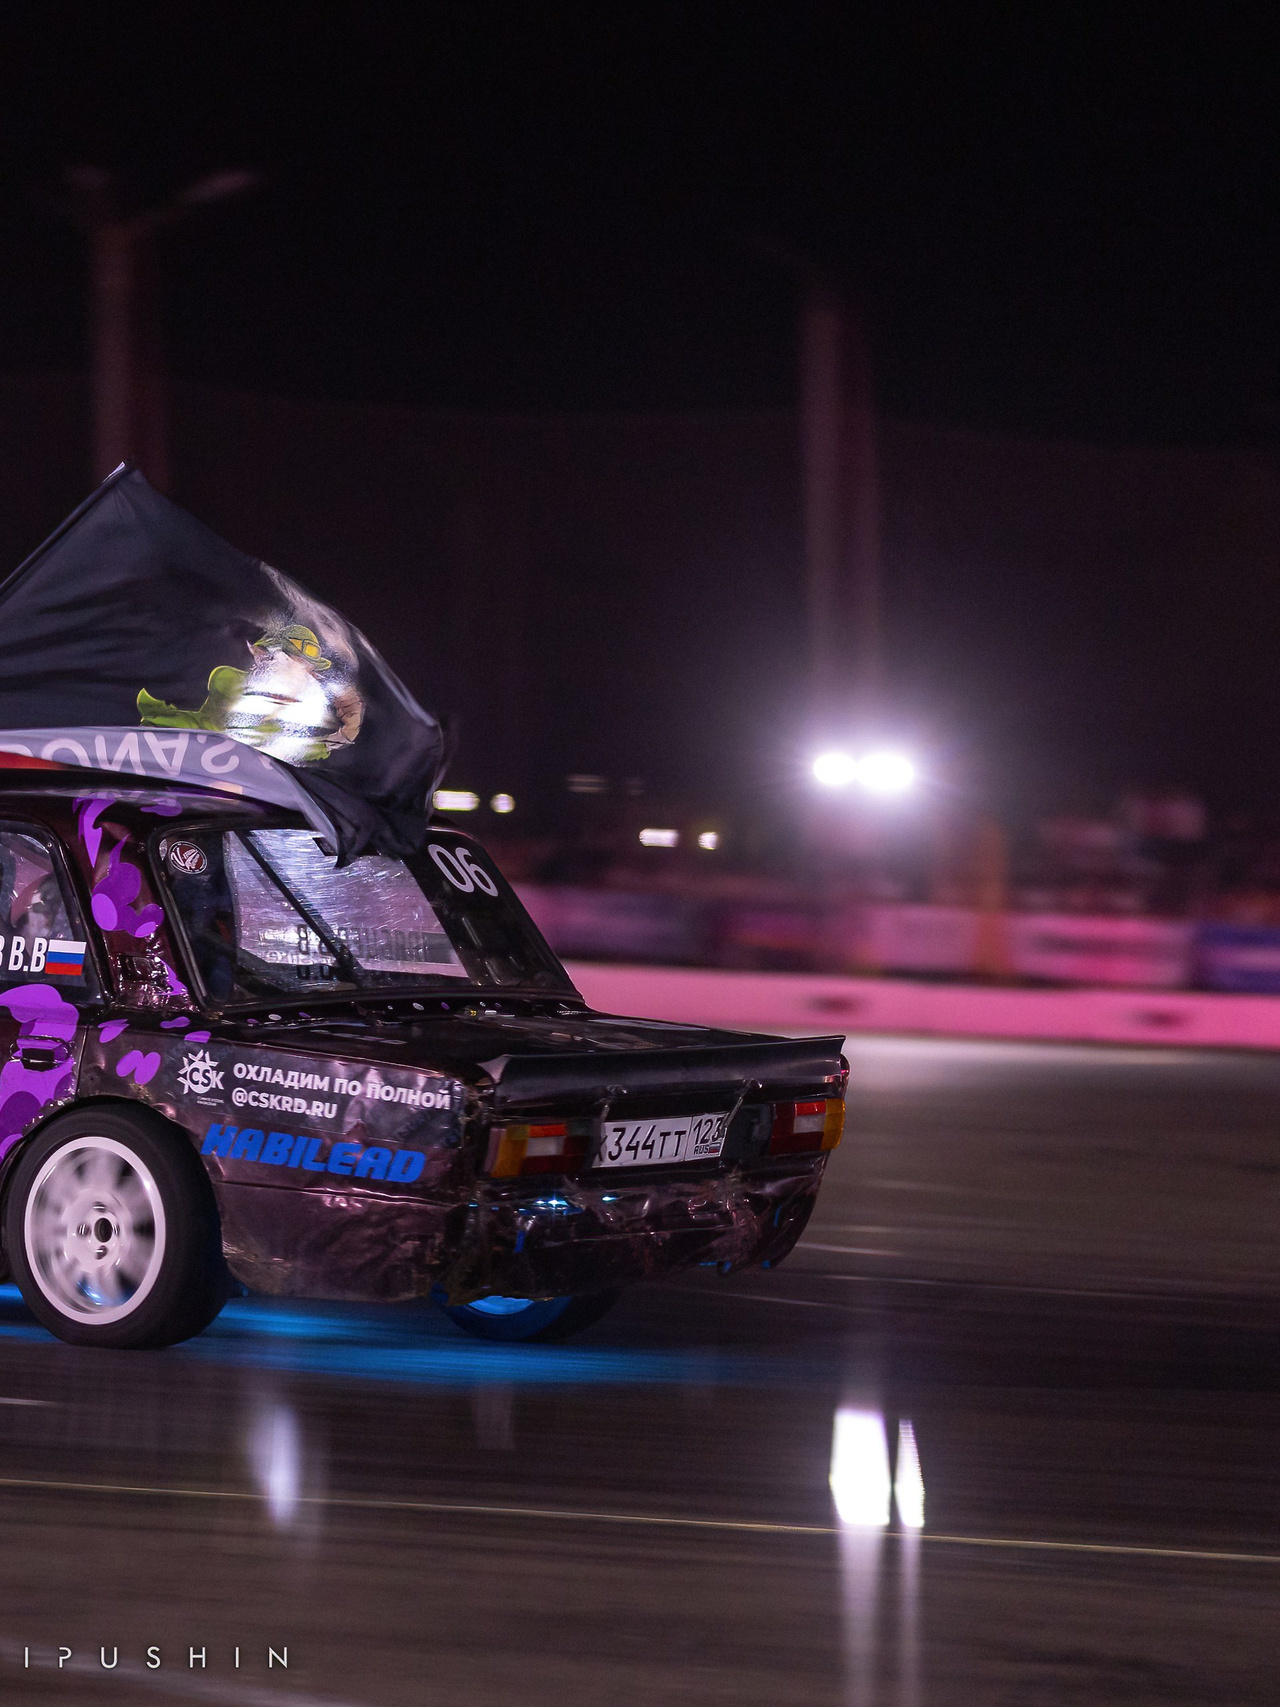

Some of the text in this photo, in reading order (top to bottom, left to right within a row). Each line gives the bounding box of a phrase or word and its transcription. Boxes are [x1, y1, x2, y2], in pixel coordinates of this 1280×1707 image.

[428, 843, 499, 897] 06
[8, 936, 48, 973] В.В
[189, 1067, 225, 1090] CSK
[233, 1062, 451, 1110] ОХЛАДИМ ПО ПОЛНОЙ
[231, 1087, 338, 1119] @CSKRD.RU
[201, 1123, 426, 1184] HABILEAD
[694, 1144, 710, 1155] RUS
